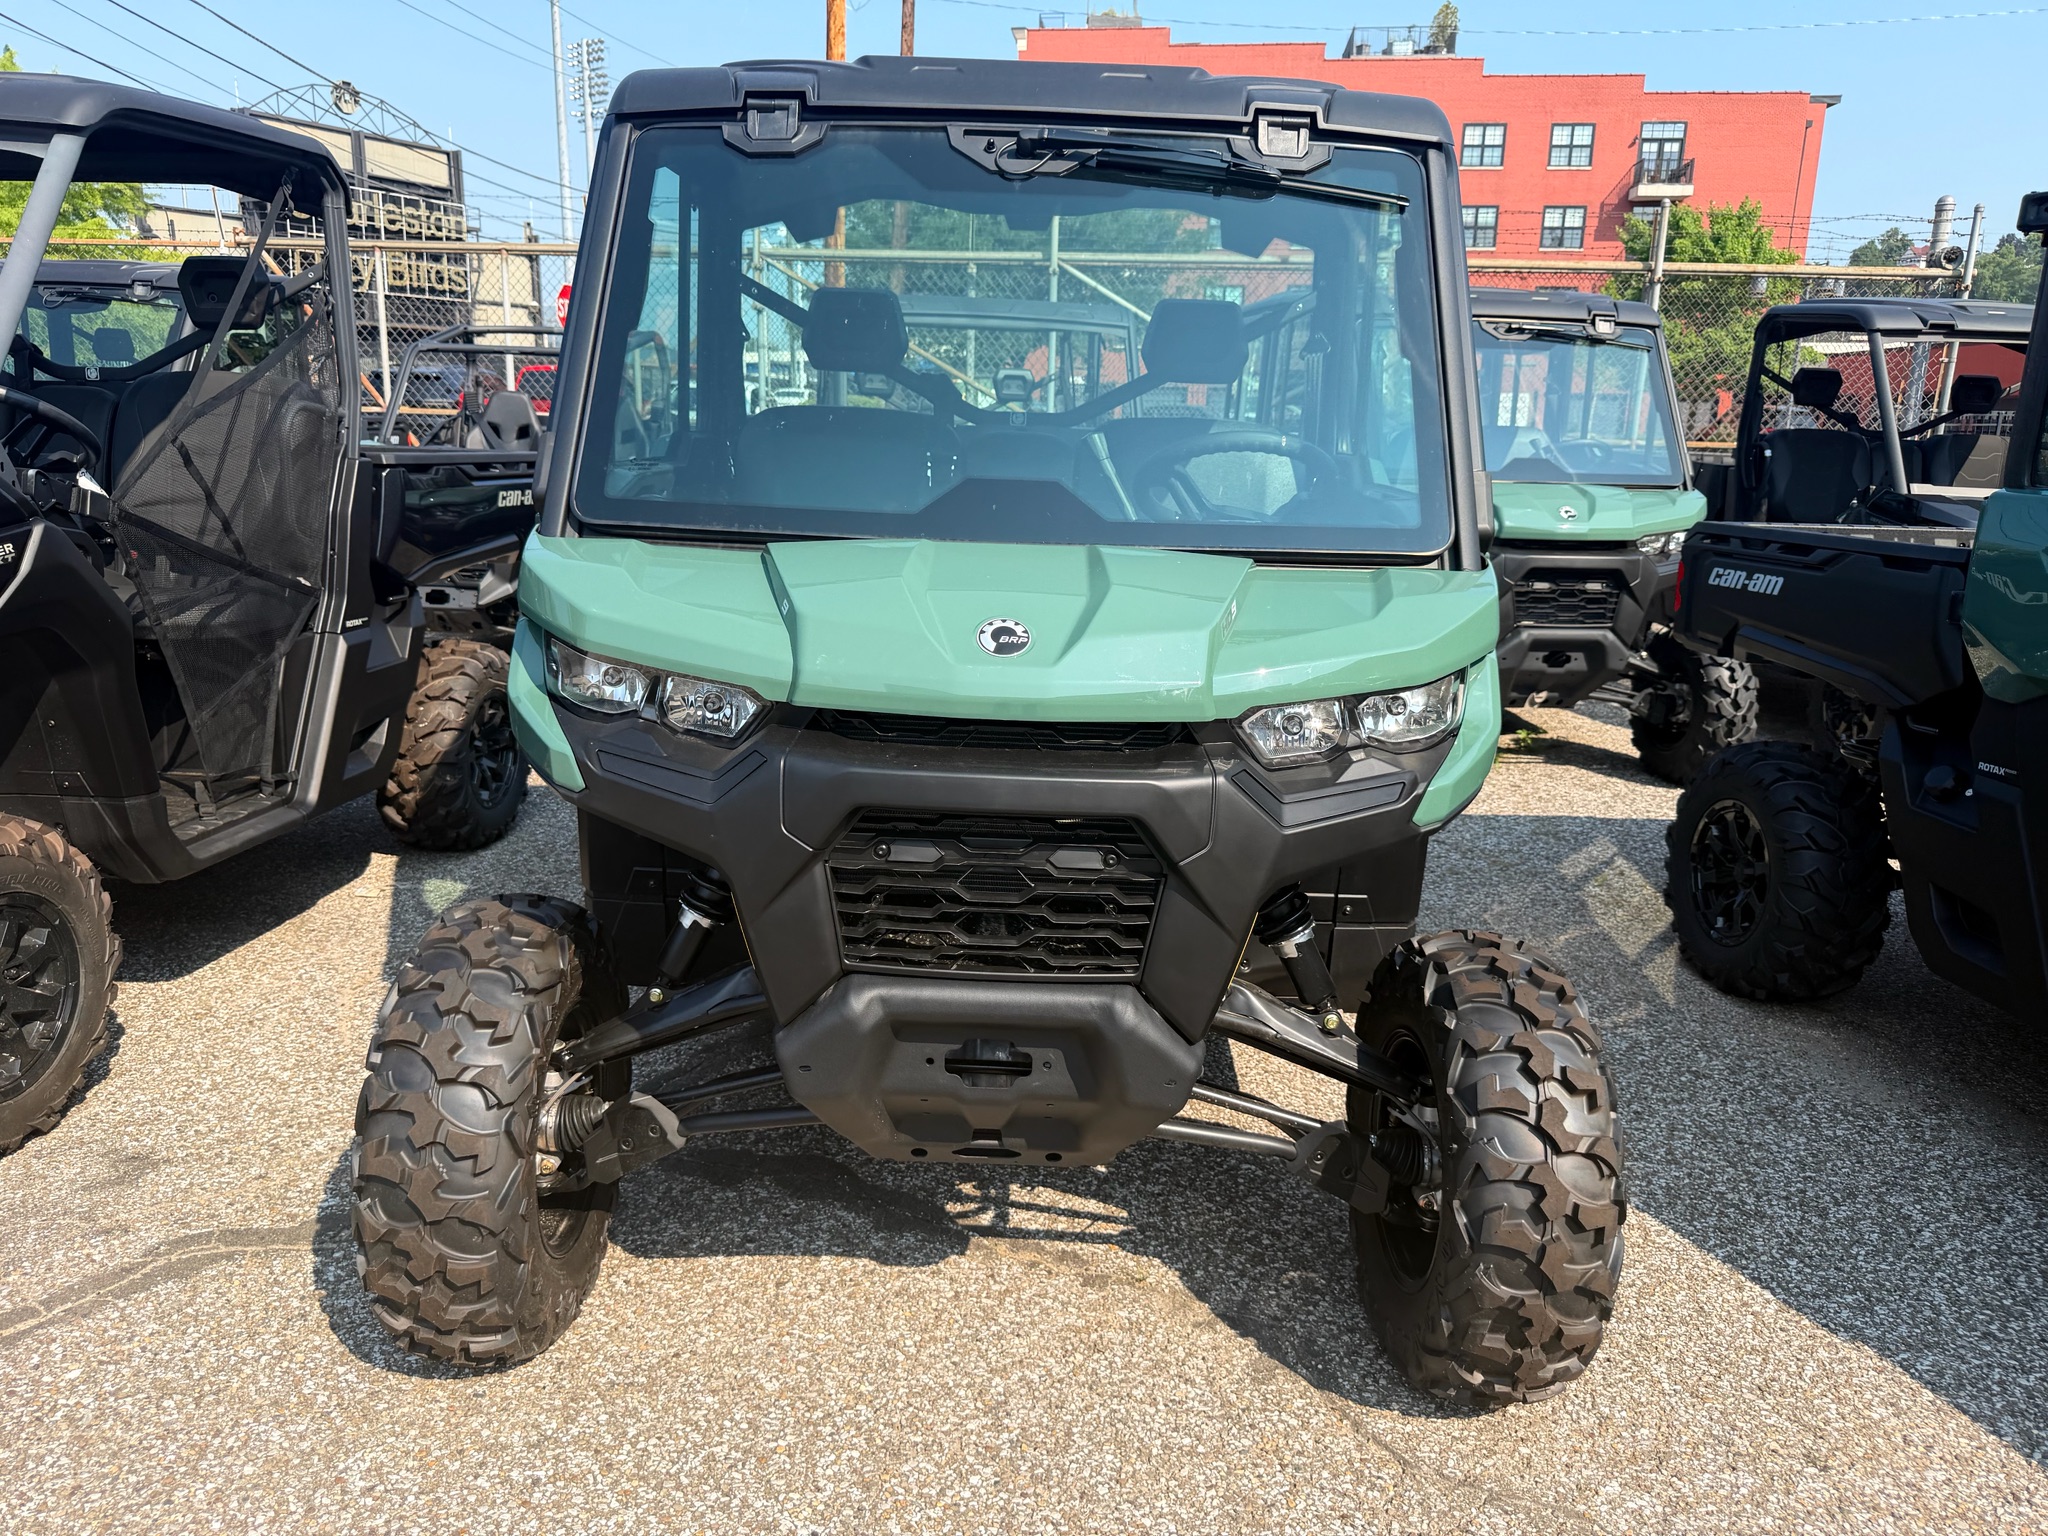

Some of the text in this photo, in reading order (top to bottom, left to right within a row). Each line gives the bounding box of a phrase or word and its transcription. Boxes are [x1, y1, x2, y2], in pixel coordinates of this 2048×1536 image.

[388, 250, 466, 293] Birds
[558, 298, 570, 318] ST
[498, 489, 534, 507] can-a
[1708, 567, 1784, 596] can-am
[999, 635, 1029, 644] BRP
[1978, 761, 2006, 776] ROTAX
